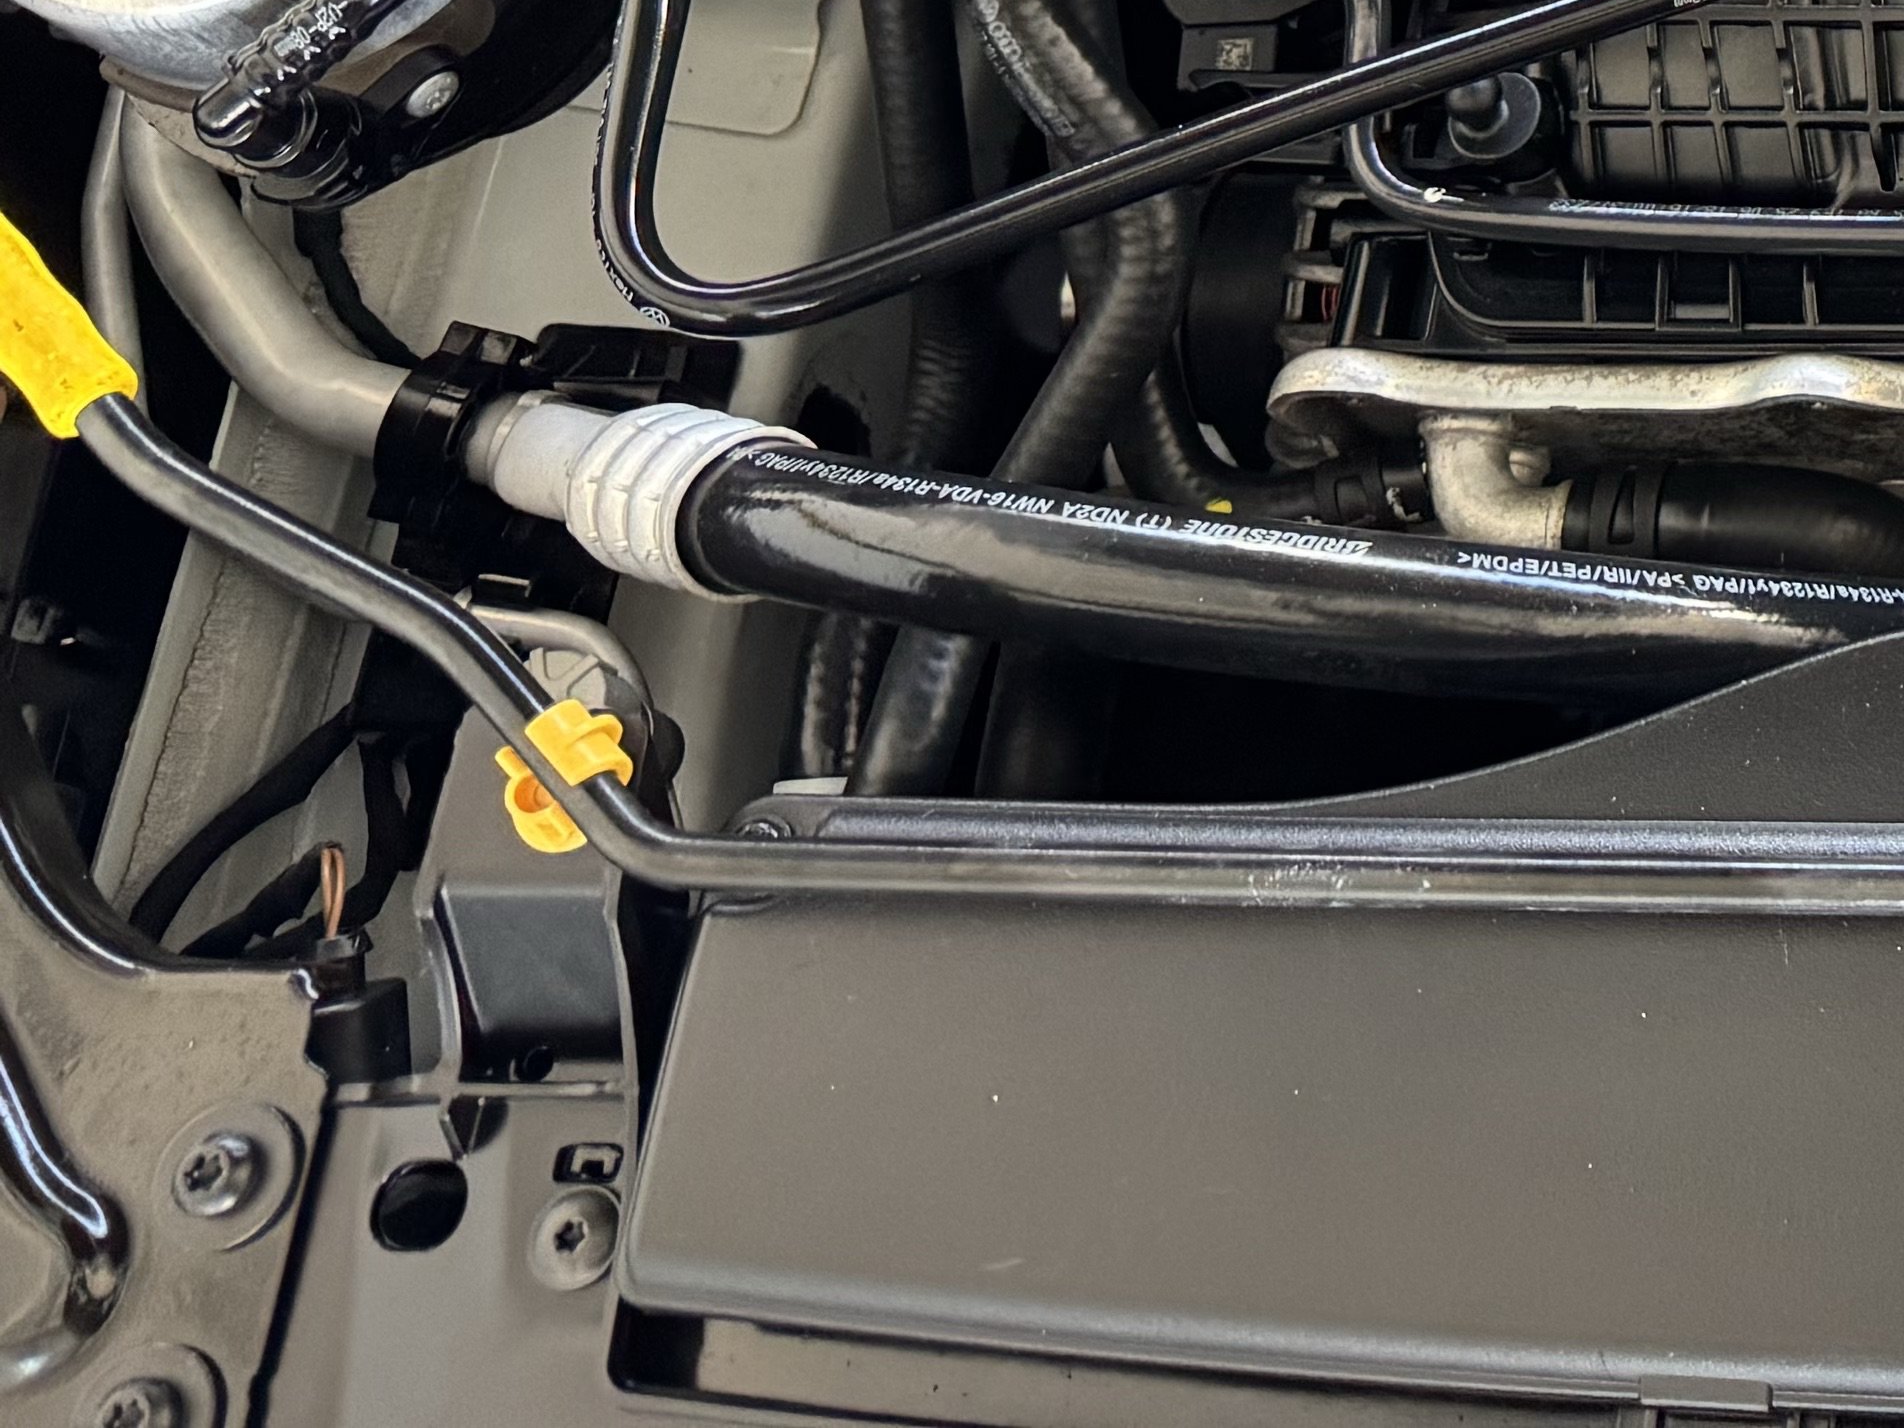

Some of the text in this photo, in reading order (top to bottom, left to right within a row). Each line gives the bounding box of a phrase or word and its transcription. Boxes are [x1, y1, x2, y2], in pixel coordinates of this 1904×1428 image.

[1062, 501, 1129, 525] ND2A
[1134, 512, 1173, 530] (T)
[1185, 516, 1372, 557] BRIDGESTONE
[1456, 549, 1682, 586] >PA/IIR/PET/EPDM<
